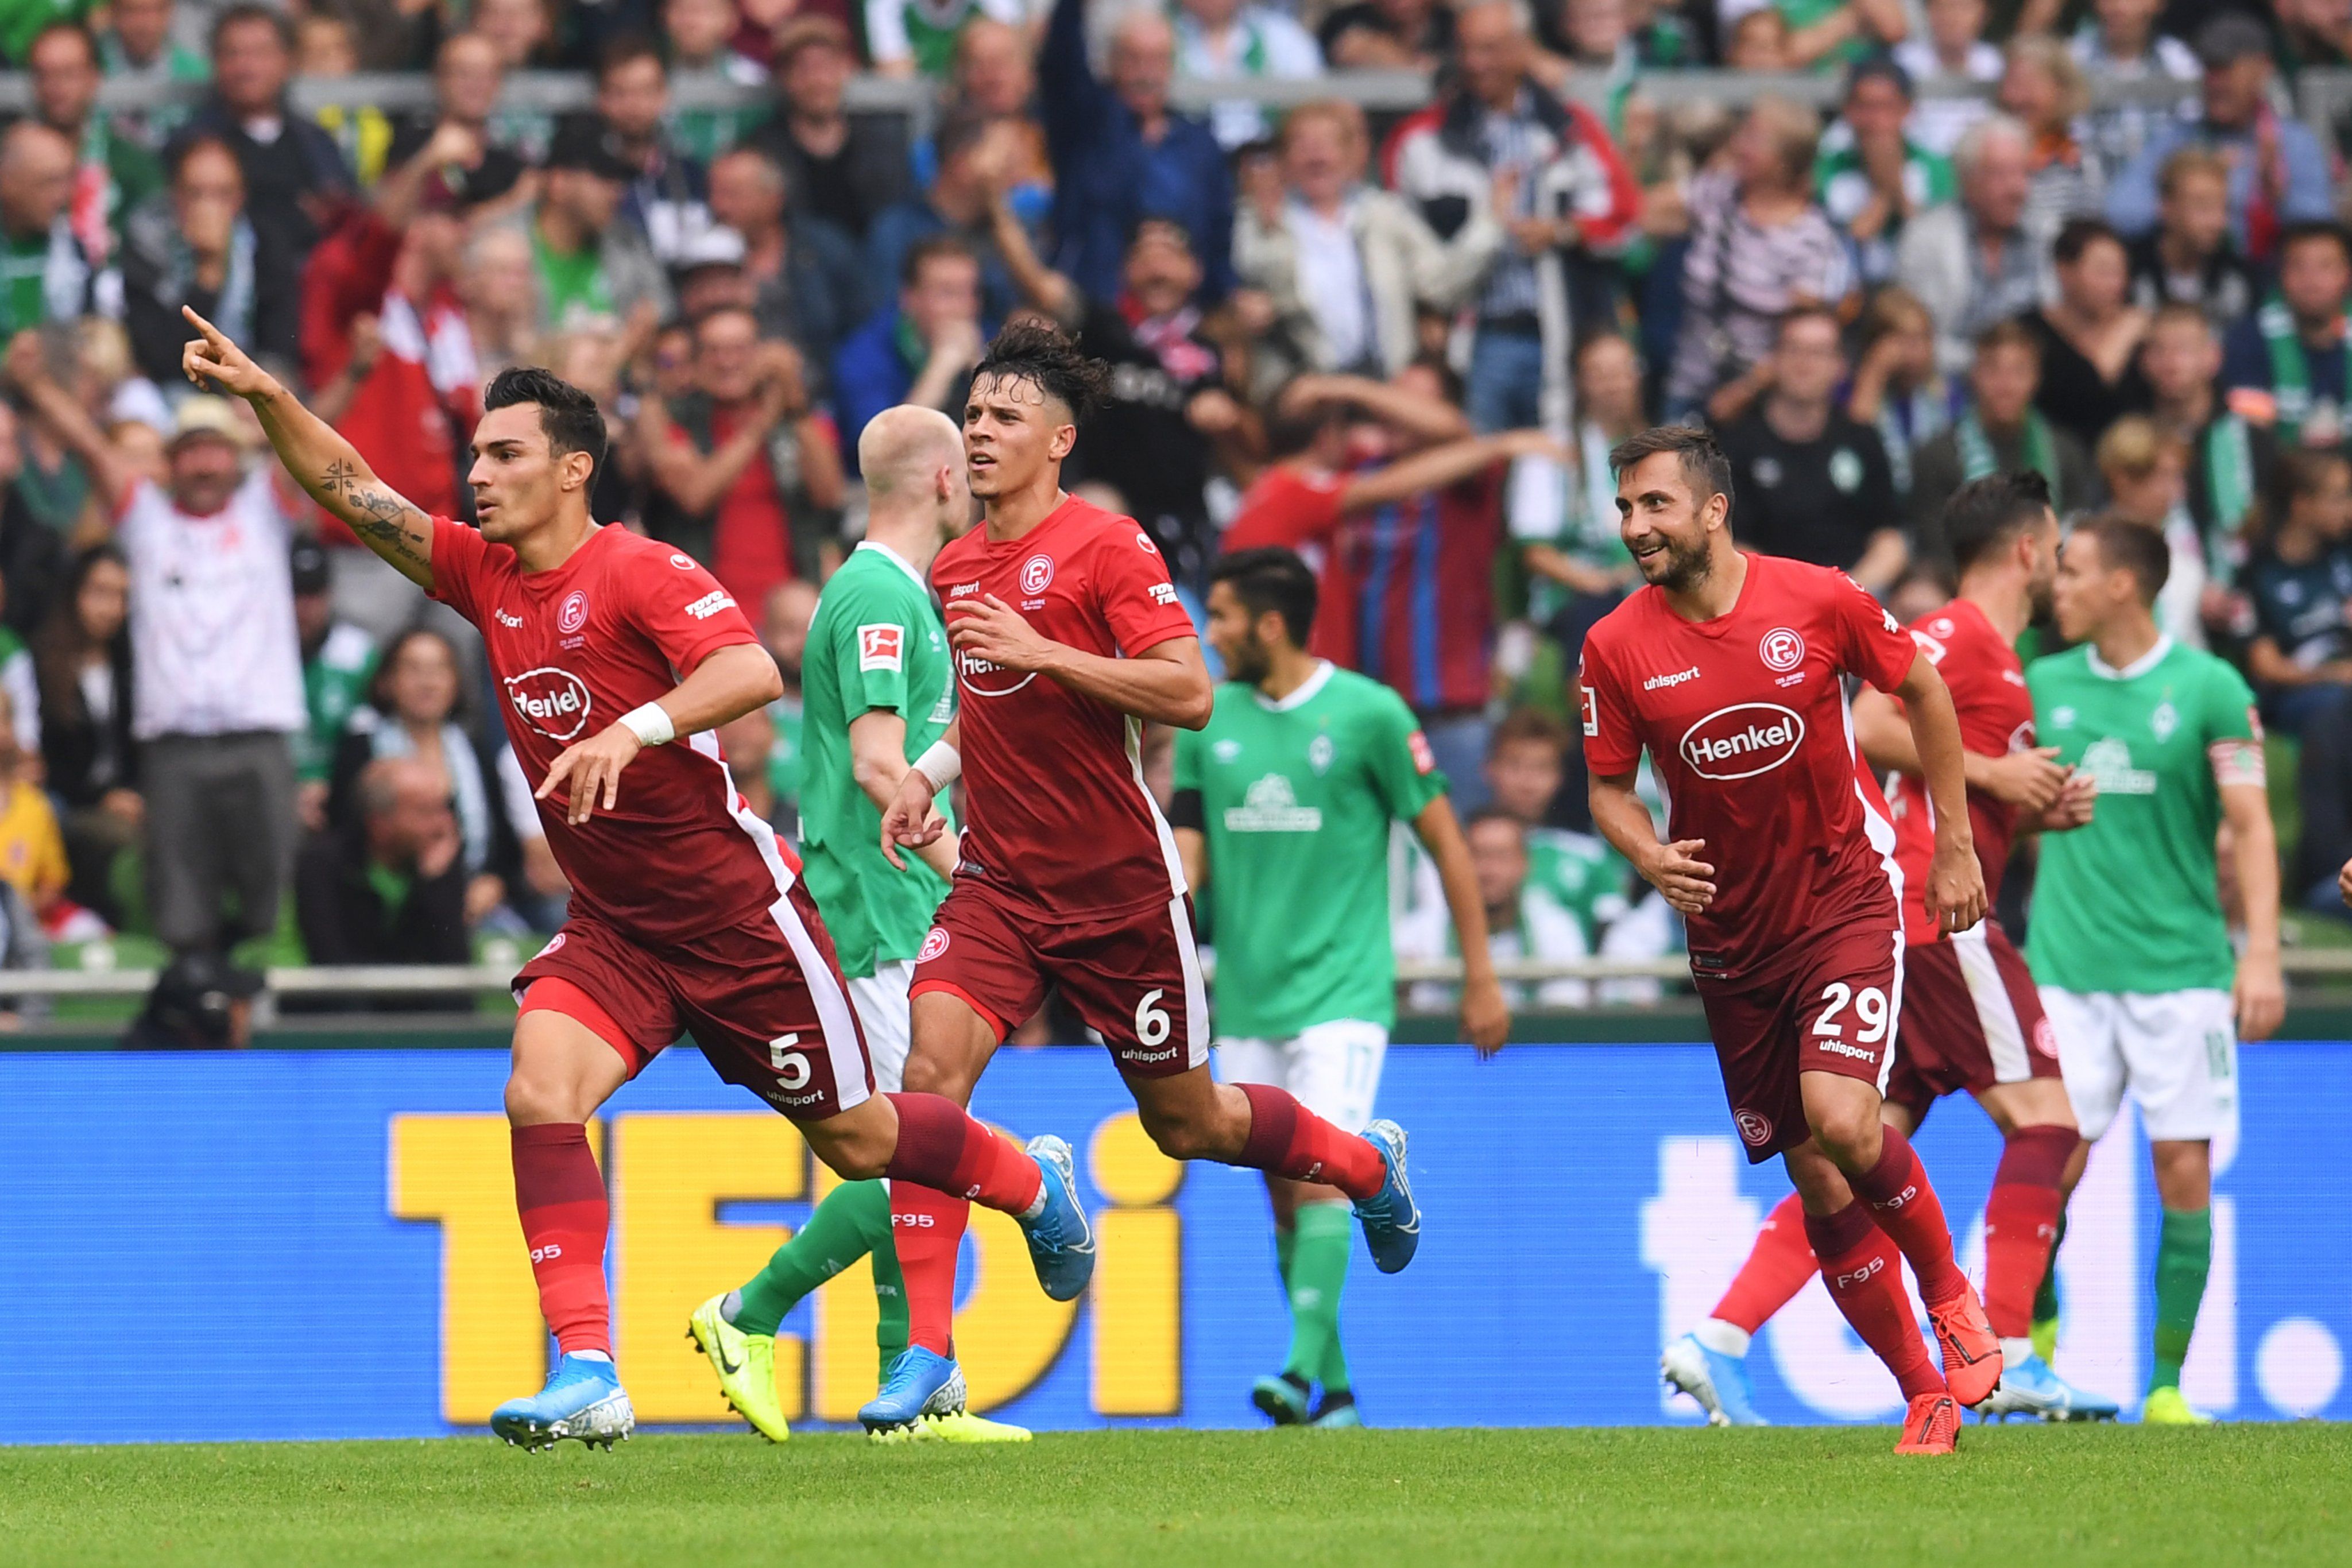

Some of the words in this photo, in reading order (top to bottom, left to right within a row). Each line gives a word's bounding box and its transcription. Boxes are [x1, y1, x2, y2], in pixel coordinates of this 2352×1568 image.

[1643, 666, 1700, 691] uhlsport
[1688, 717, 1793, 765] Henkel
[1135, 988, 1170, 1047] 6
[1812, 982, 1888, 1043] 29
[769, 1032, 811, 1090] 5
[1121, 1046, 1177, 1063] uhlsport
[1819, 1039, 1875, 1064] uhlsport
[767, 1089, 825, 1107] uhlsport
[1873, 1184, 1917, 1211] F95
[891, 1213, 935, 1228] F95
[389, 1113, 1184, 1424] TEDi
[1837, 1256, 1885, 1289] F95
